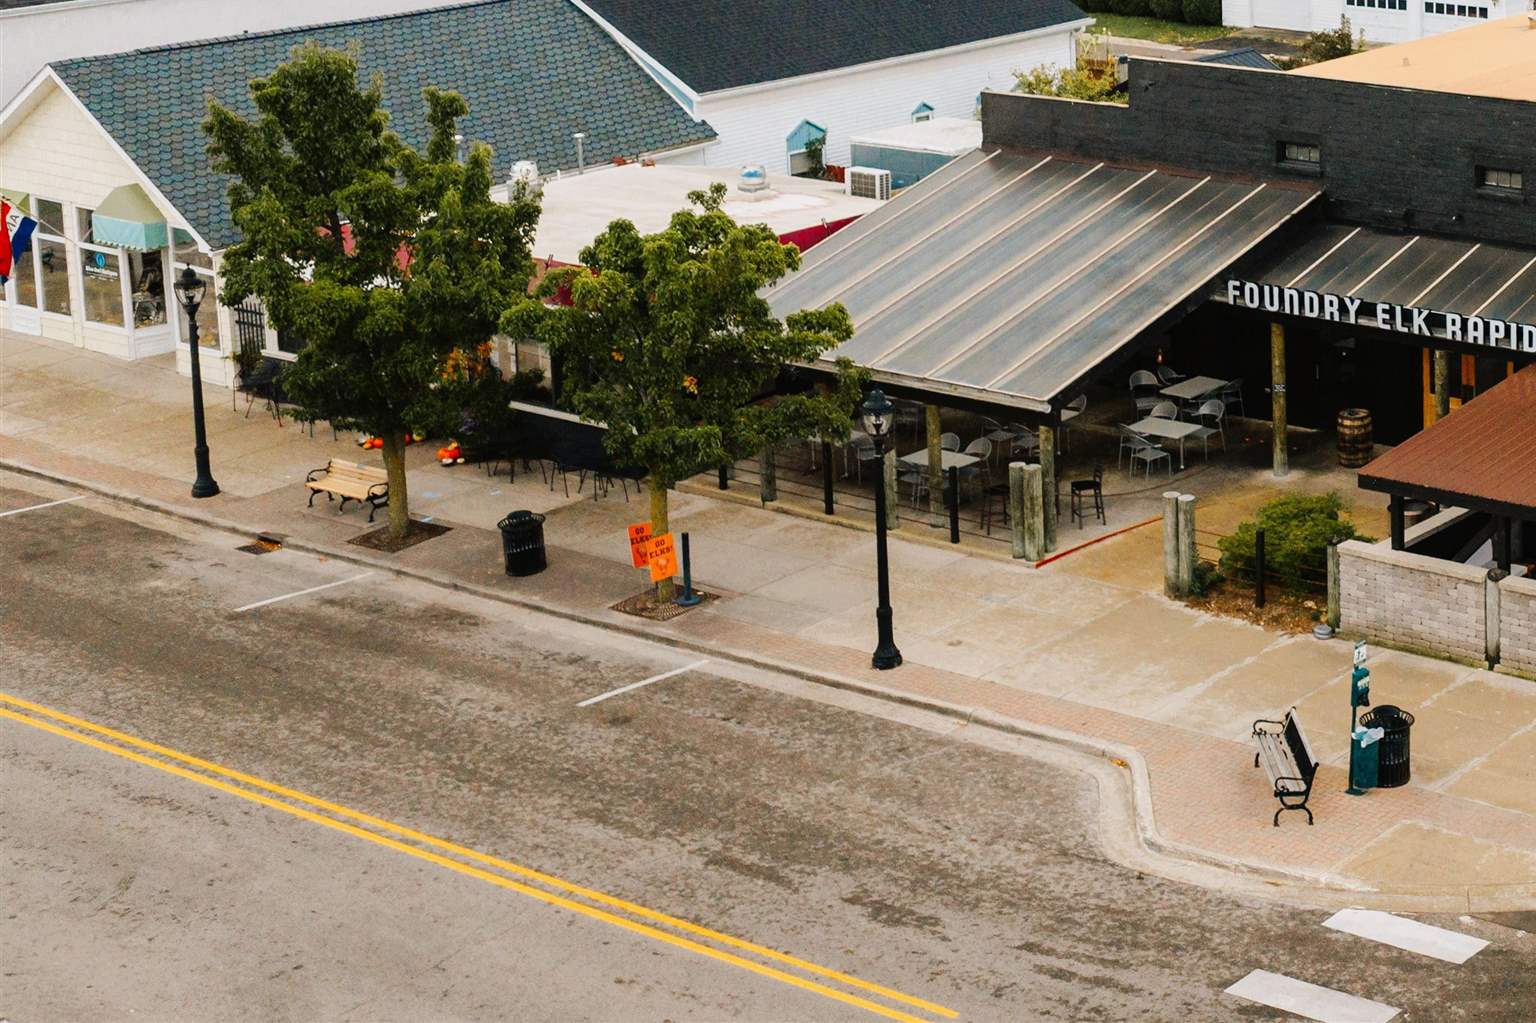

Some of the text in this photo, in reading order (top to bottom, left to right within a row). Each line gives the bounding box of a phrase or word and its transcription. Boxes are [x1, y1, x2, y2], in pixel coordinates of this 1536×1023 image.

[1227, 280, 1362, 323] FOUNDRY
[1376, 302, 1431, 337] ELK
[655, 539, 665, 547] GO
